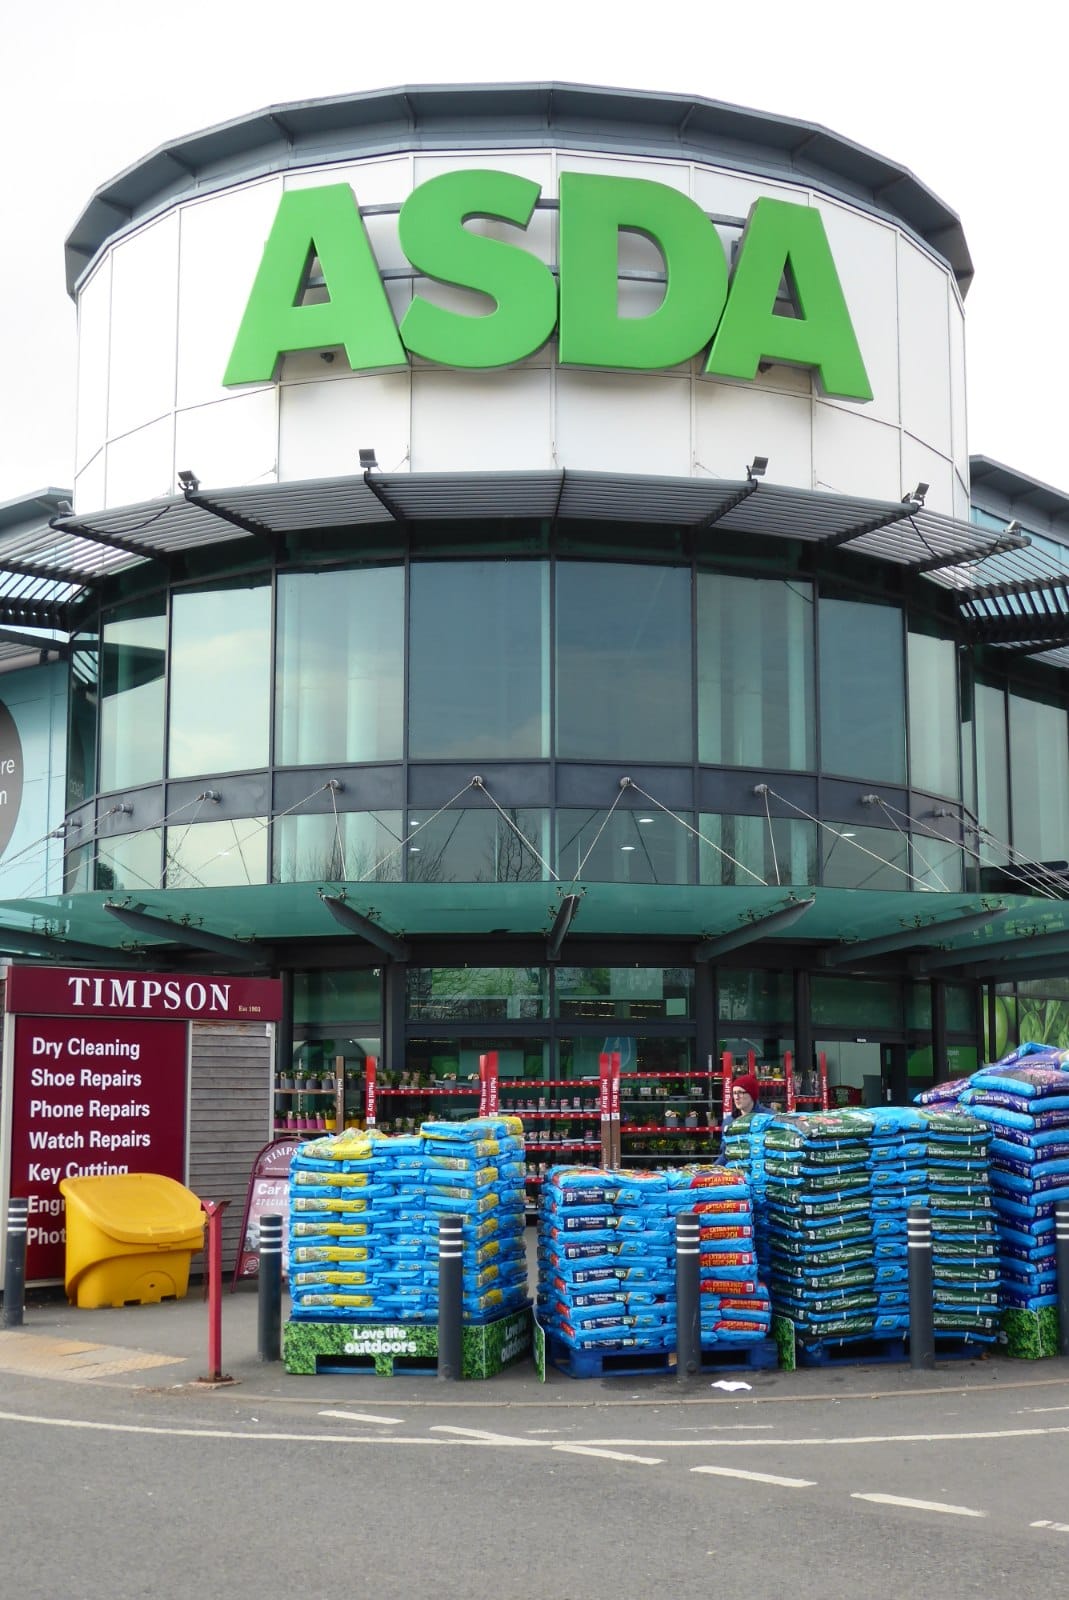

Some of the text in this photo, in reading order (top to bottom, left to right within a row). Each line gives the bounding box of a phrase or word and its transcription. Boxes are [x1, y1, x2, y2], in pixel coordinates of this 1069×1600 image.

[223, 170, 873, 400] ASDA
[68, 977, 231, 1011] TIMPSON
[32, 1036, 141, 1061] Dry Cleaning
[31, 1068, 142, 1091] Shoe Repairs
[31, 1099, 151, 1121] Phone Repairs
[29, 1129, 151, 1152] Watch Repairs
[28, 1161, 129, 1185] Key Cutting
[258, 1183, 281, 1195] Car
[353, 1327, 407, 1340] Love life
[344, 1339, 417, 1354] outdoors
